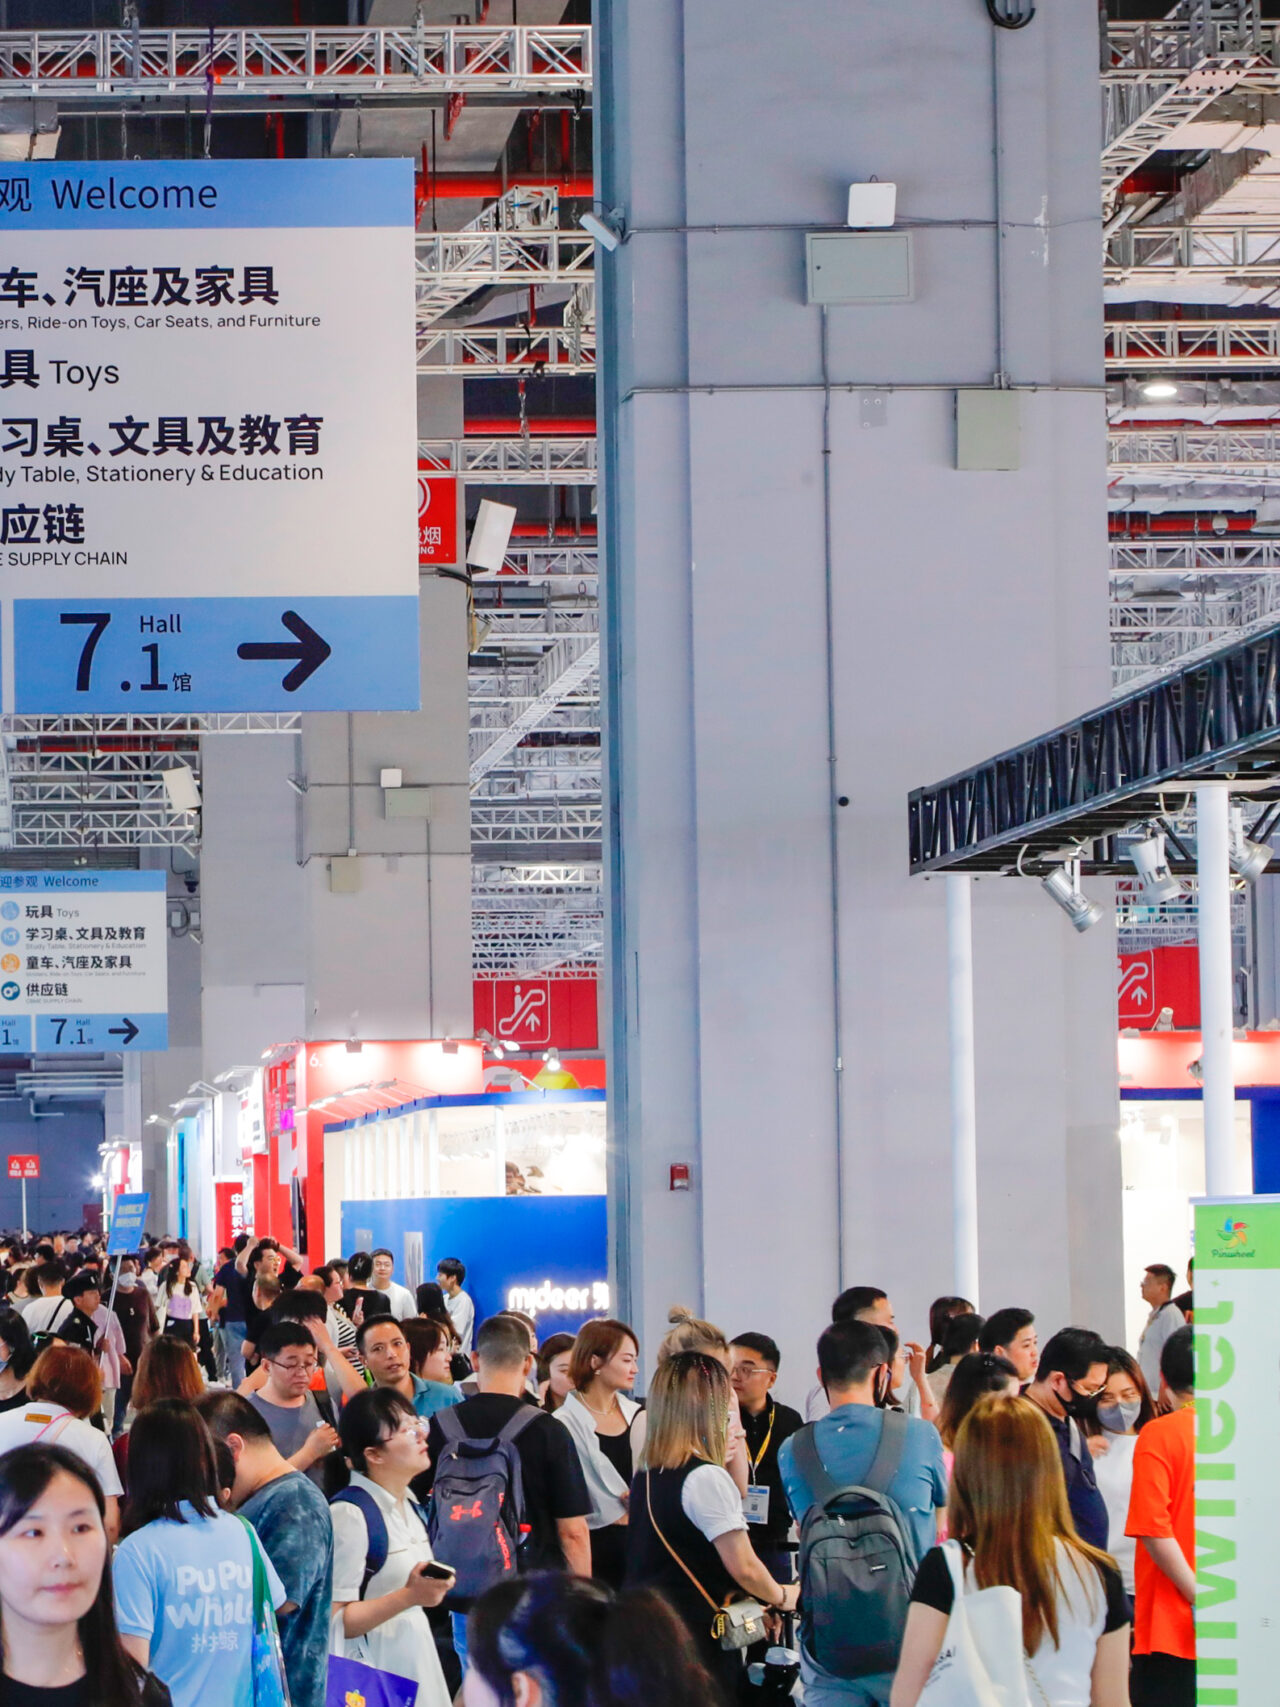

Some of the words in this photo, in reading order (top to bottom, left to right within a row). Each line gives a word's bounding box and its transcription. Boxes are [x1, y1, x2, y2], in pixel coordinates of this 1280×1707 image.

[50, 176, 217, 210] Welcome
[27, 316, 88, 329] Ride-on
[91, 315, 130, 332] Toys,
[134, 315, 162, 329] Car
[165, 314, 213, 328] Seats,
[217, 314, 246, 328] and
[249, 314, 321, 328] Furniture
[48, 360, 120, 392] Toys
[20, 465, 80, 483] Table,
[86, 465, 196, 486] Stationery
[200, 464, 215, 481] &
[219, 463, 323, 481] Education
[8, 552, 71, 567] SUPPLY
[74, 551, 128, 566] CHAIN
[140, 613, 182, 633] Hall
[172, 672, 192, 693] 馆
[43, 875, 99, 887] Welcome
[25, 905, 53, 919] 玩具
[56, 908, 80, 919] Toys
[25, 926, 146, 942] 学习桌、文具及教育
[26, 955, 132, 970] 童车、汽座及家具
[25, 982, 68, 997] 供应链
[75, 1018, 91, 1026] Hall
